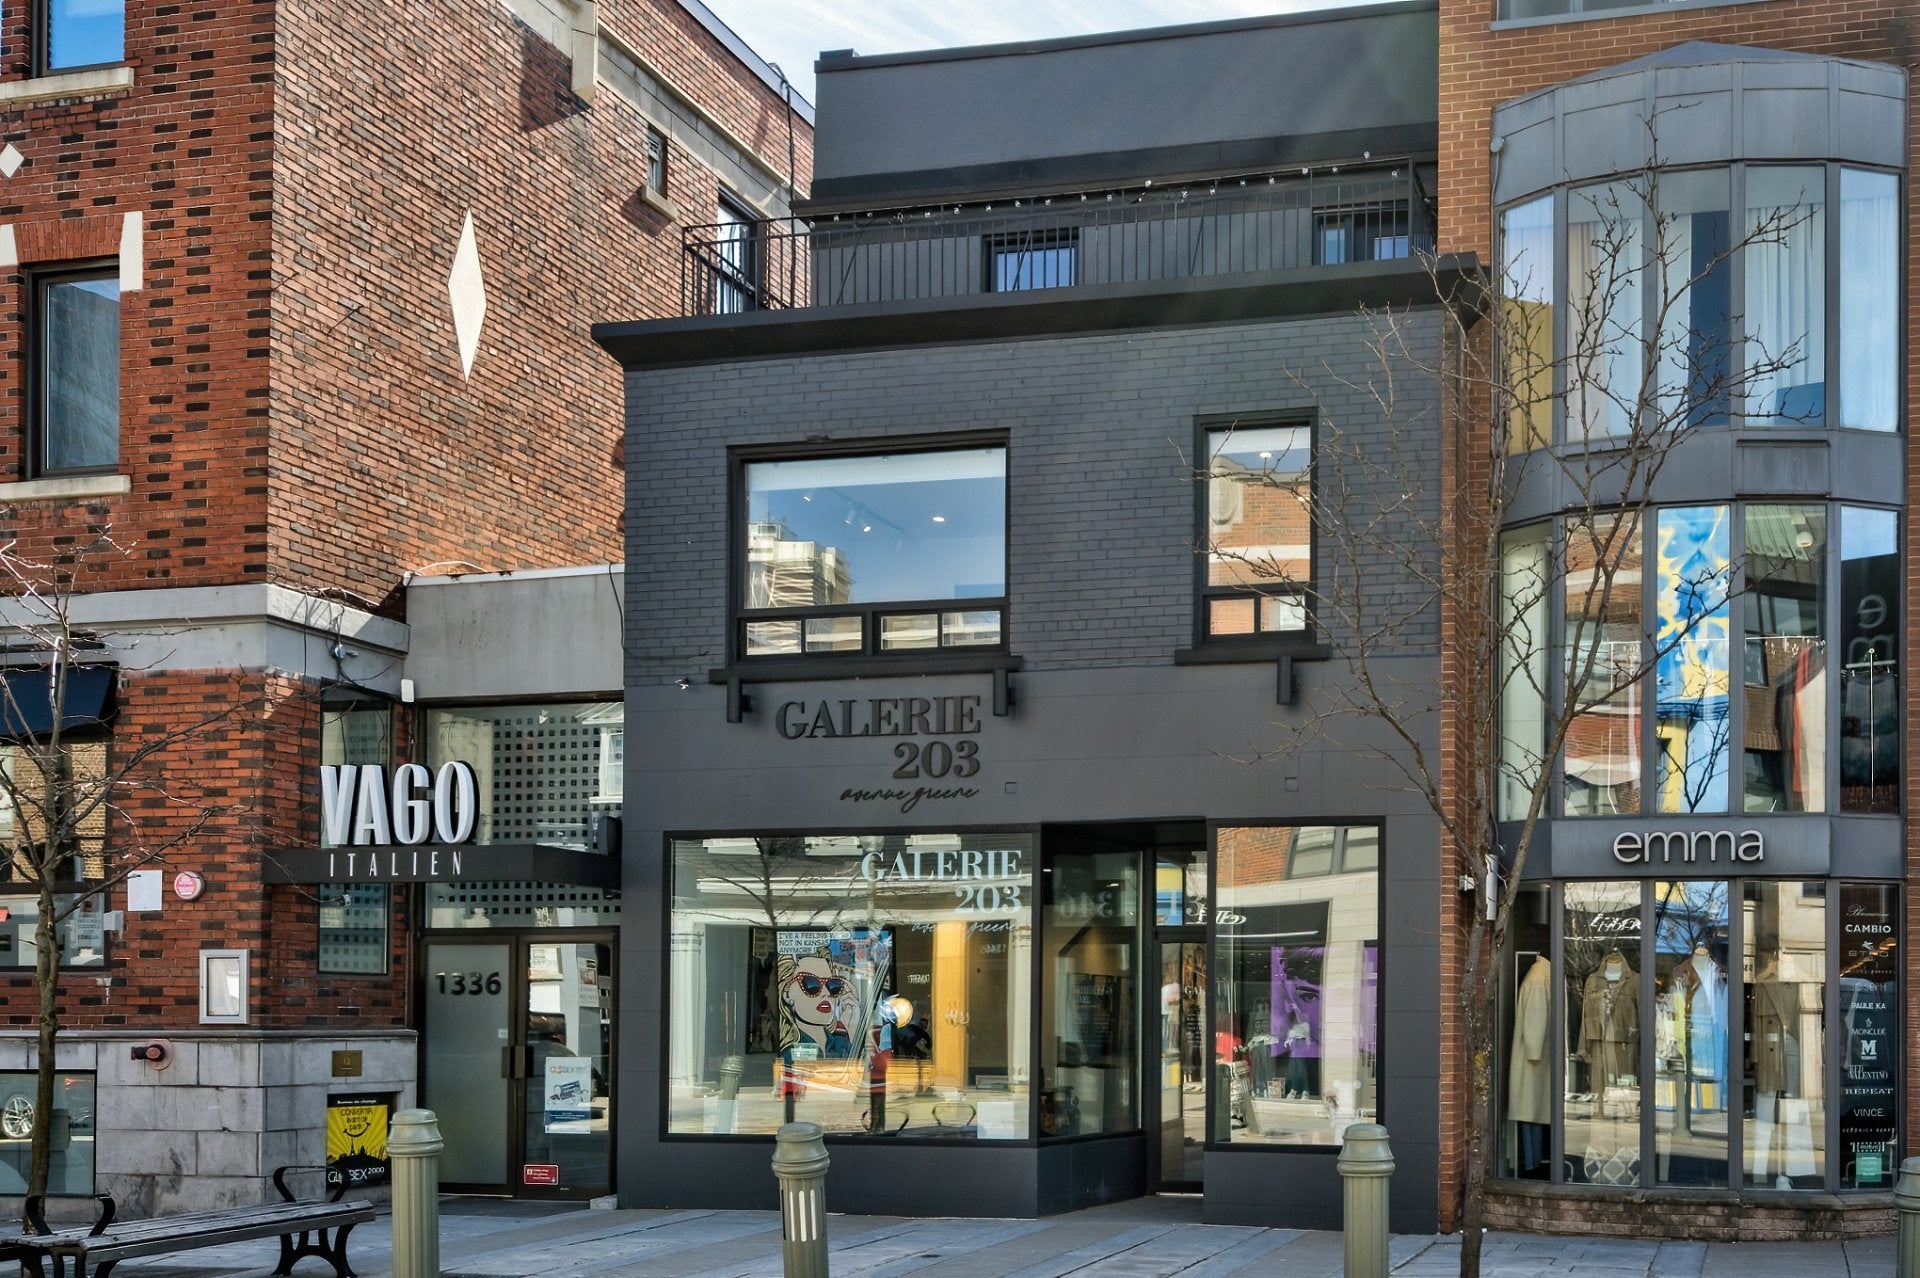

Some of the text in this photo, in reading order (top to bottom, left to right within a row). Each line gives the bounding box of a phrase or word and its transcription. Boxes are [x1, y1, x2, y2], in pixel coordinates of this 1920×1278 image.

[775, 695, 981, 739] GALERIE
[892, 740, 980, 778] 203
[320, 761, 476, 845] VAGO
[840, 786, 980, 814] avenue greene
[1613, 829, 1764, 863] emma
[329, 851, 461, 877] ITALIEN
[861, 850, 1022, 881] GALERIE
[954, 884, 1022, 914] 203
[1845, 924, 1891, 933] CAMBIO
[435, 972, 501, 995] 1336
